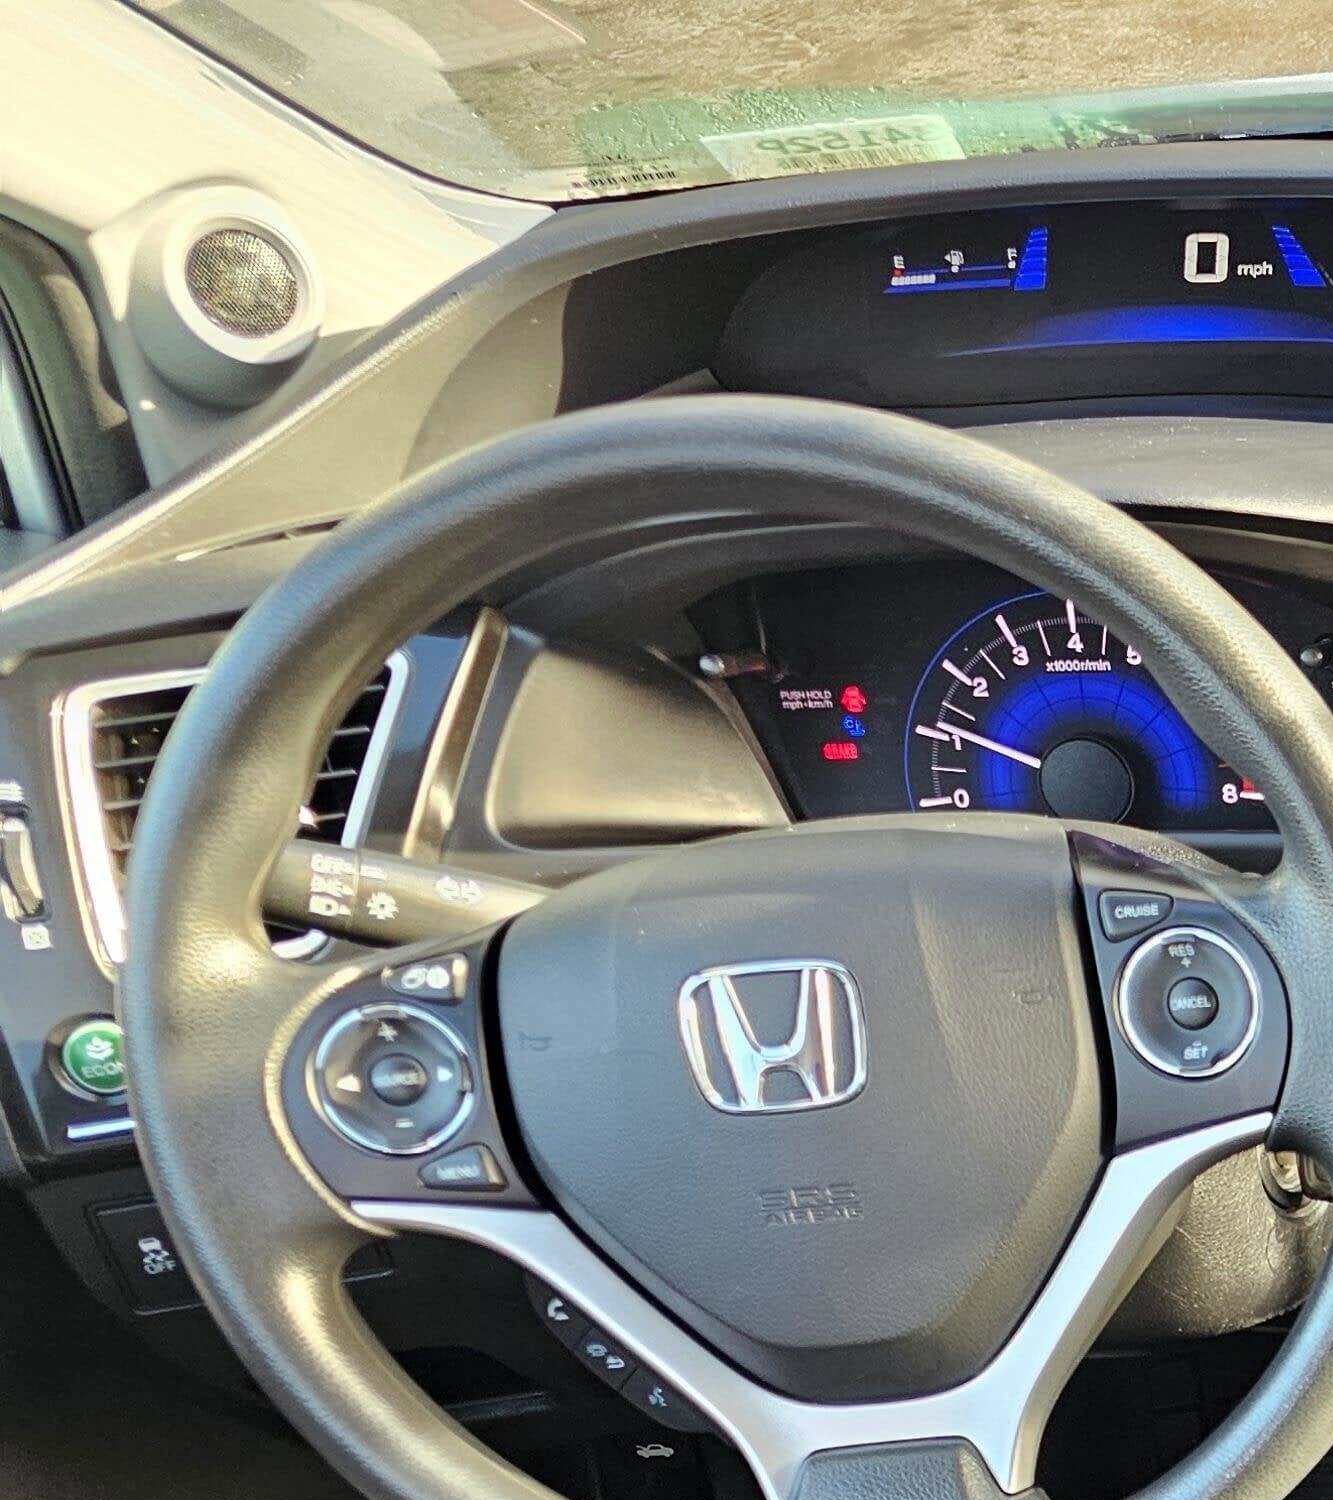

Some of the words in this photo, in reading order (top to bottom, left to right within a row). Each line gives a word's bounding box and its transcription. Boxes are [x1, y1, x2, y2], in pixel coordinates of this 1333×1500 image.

[1184, 232, 1230, 283] 0
[1237, 261, 1273, 279] mph
[1066, 632, 1085, 653] 4
[1012, 645, 1030, 667] 3
[1126, 645, 1143, 666] 5
[1046, 658, 1112, 673] x1000r/min
[780, 690, 805, 700] PUSH
[806, 690, 832, 700] HOLD
[972, 676, 990, 698] 2
[951, 734, 962, 751] 1
[953, 788, 970, 809] 0
[1221, 783, 1239, 804] 8
[1114, 903, 1160, 919] CRUISE
[1168, 943, 1195, 958] RES
[1171, 995, 1212, 1011] CANCEL
[1183, 1045, 1209, 1060] SET
